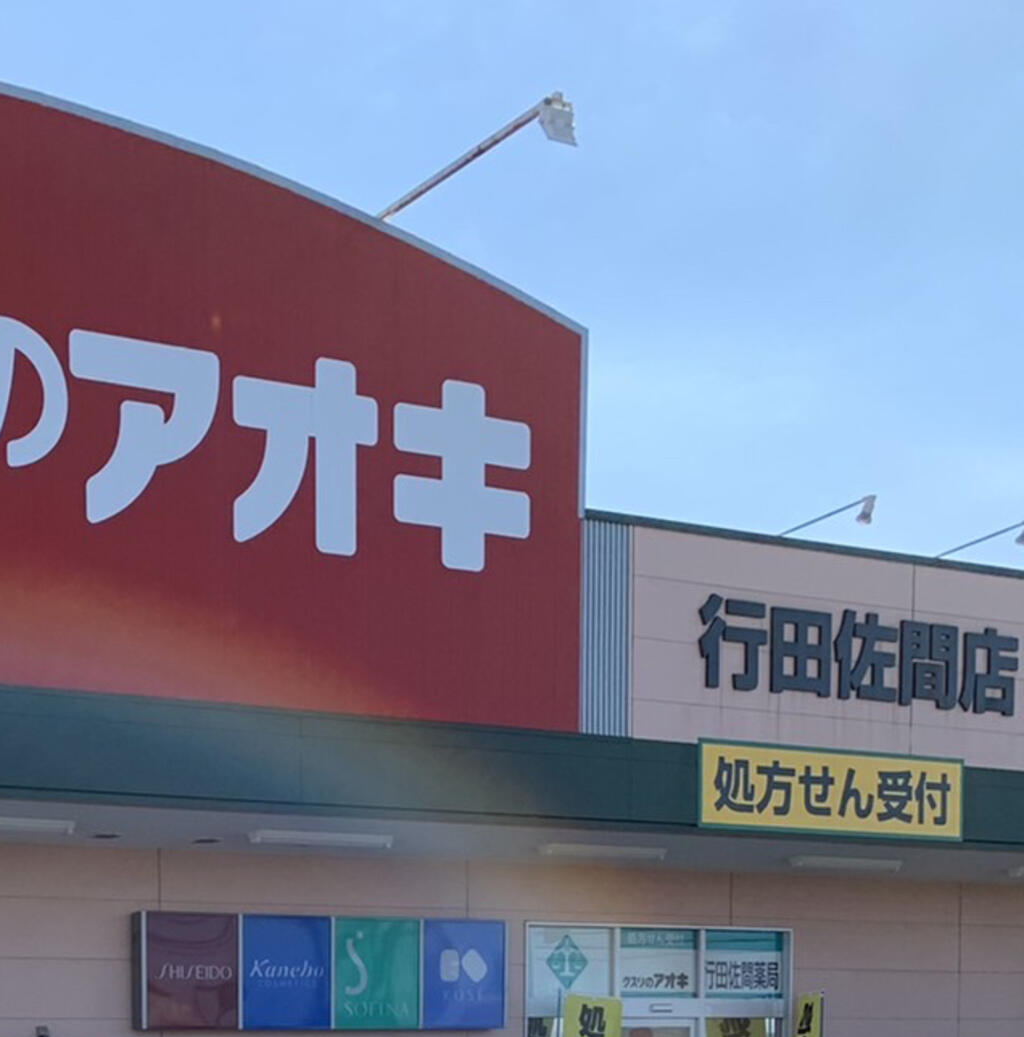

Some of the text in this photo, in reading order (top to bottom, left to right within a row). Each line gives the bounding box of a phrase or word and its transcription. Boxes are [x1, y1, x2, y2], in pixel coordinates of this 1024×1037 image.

[698, 593, 1019, 716] 行田佐間店
[714, 756, 951, 826] 処方せん受付
[155, 962, 233, 981] SHISEIDO
[249, 958, 326, 979] Kanebo
[705, 961, 779, 990] 行田佐間薬局
[622, 972, 689, 989] クスリのアオキ
[344, 1002, 410, 1017] SOFINA
